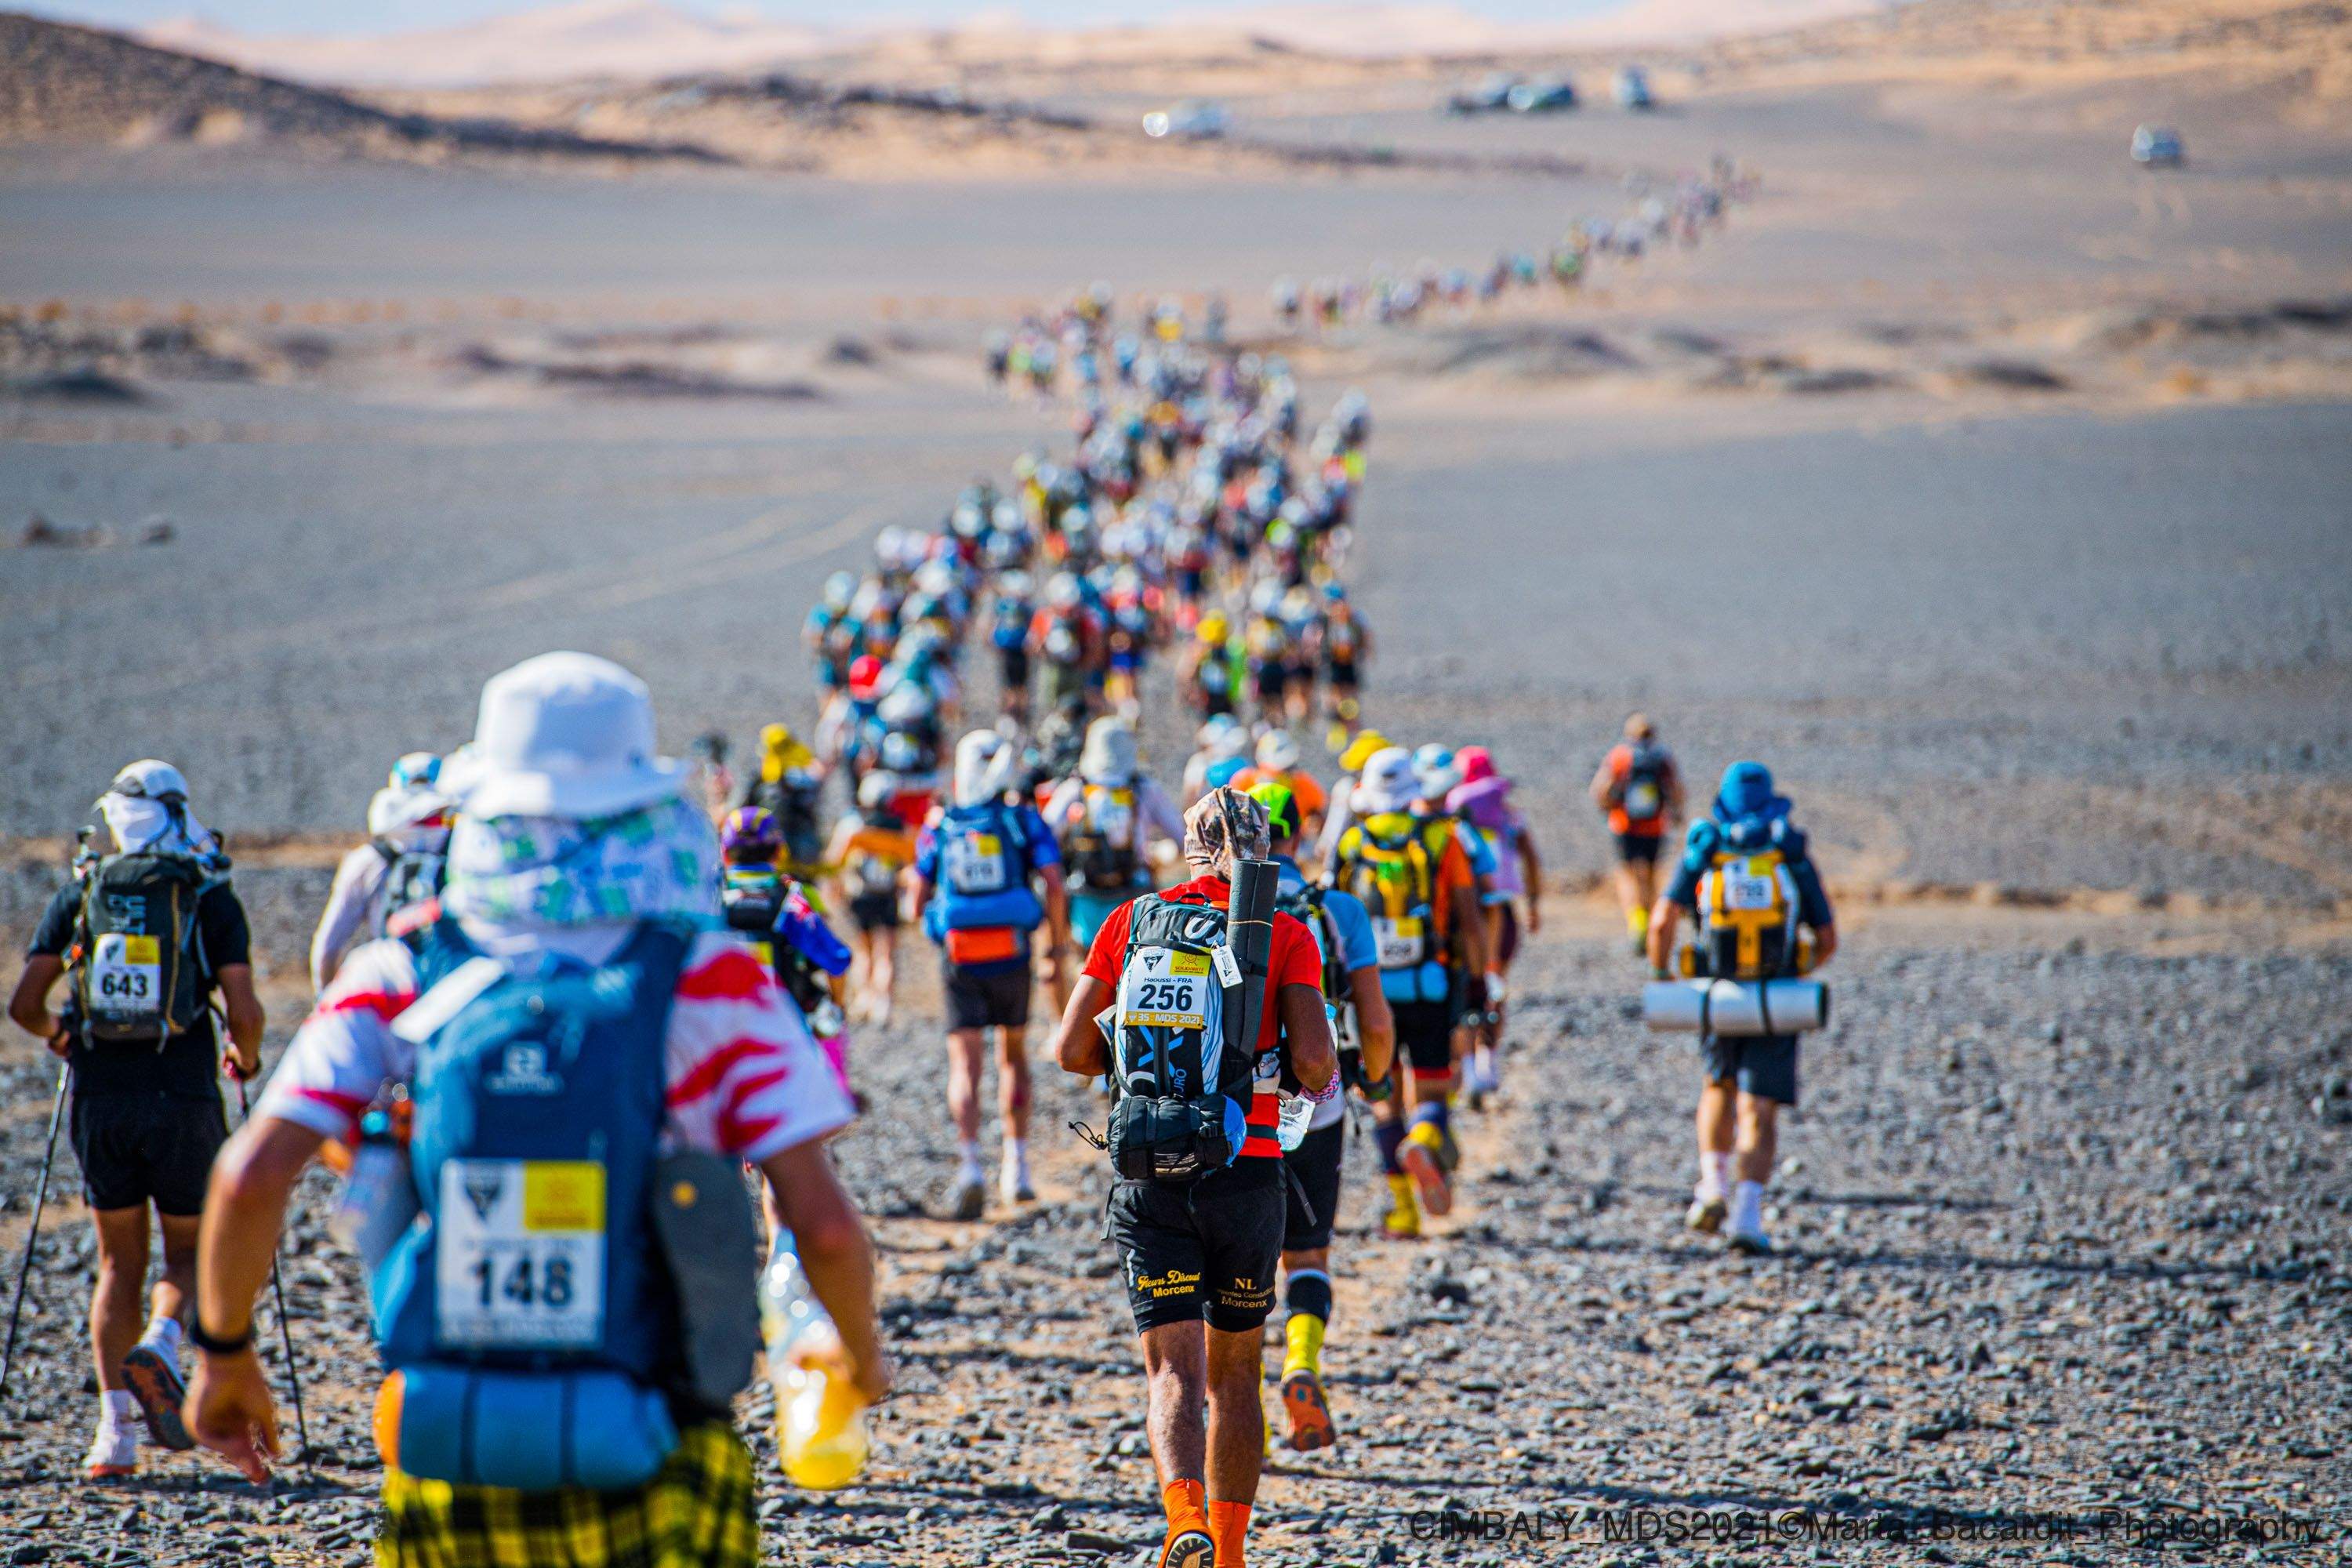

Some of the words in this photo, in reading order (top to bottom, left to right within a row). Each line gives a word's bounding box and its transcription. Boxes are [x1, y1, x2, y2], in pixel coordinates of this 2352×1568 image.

[102, 974, 147, 996] 643
[1138, 984, 1192, 1011] 256
[1155, 1014, 1178, 1022] MDS
[1178, 1015, 1200, 1024] 2021
[472, 1257, 574, 1308] 148
[1234, 1278, 1257, 1290] NL
[1152, 1286, 1195, 1298] Morcenx
[1221, 1296, 1268, 1308] Morcenx
